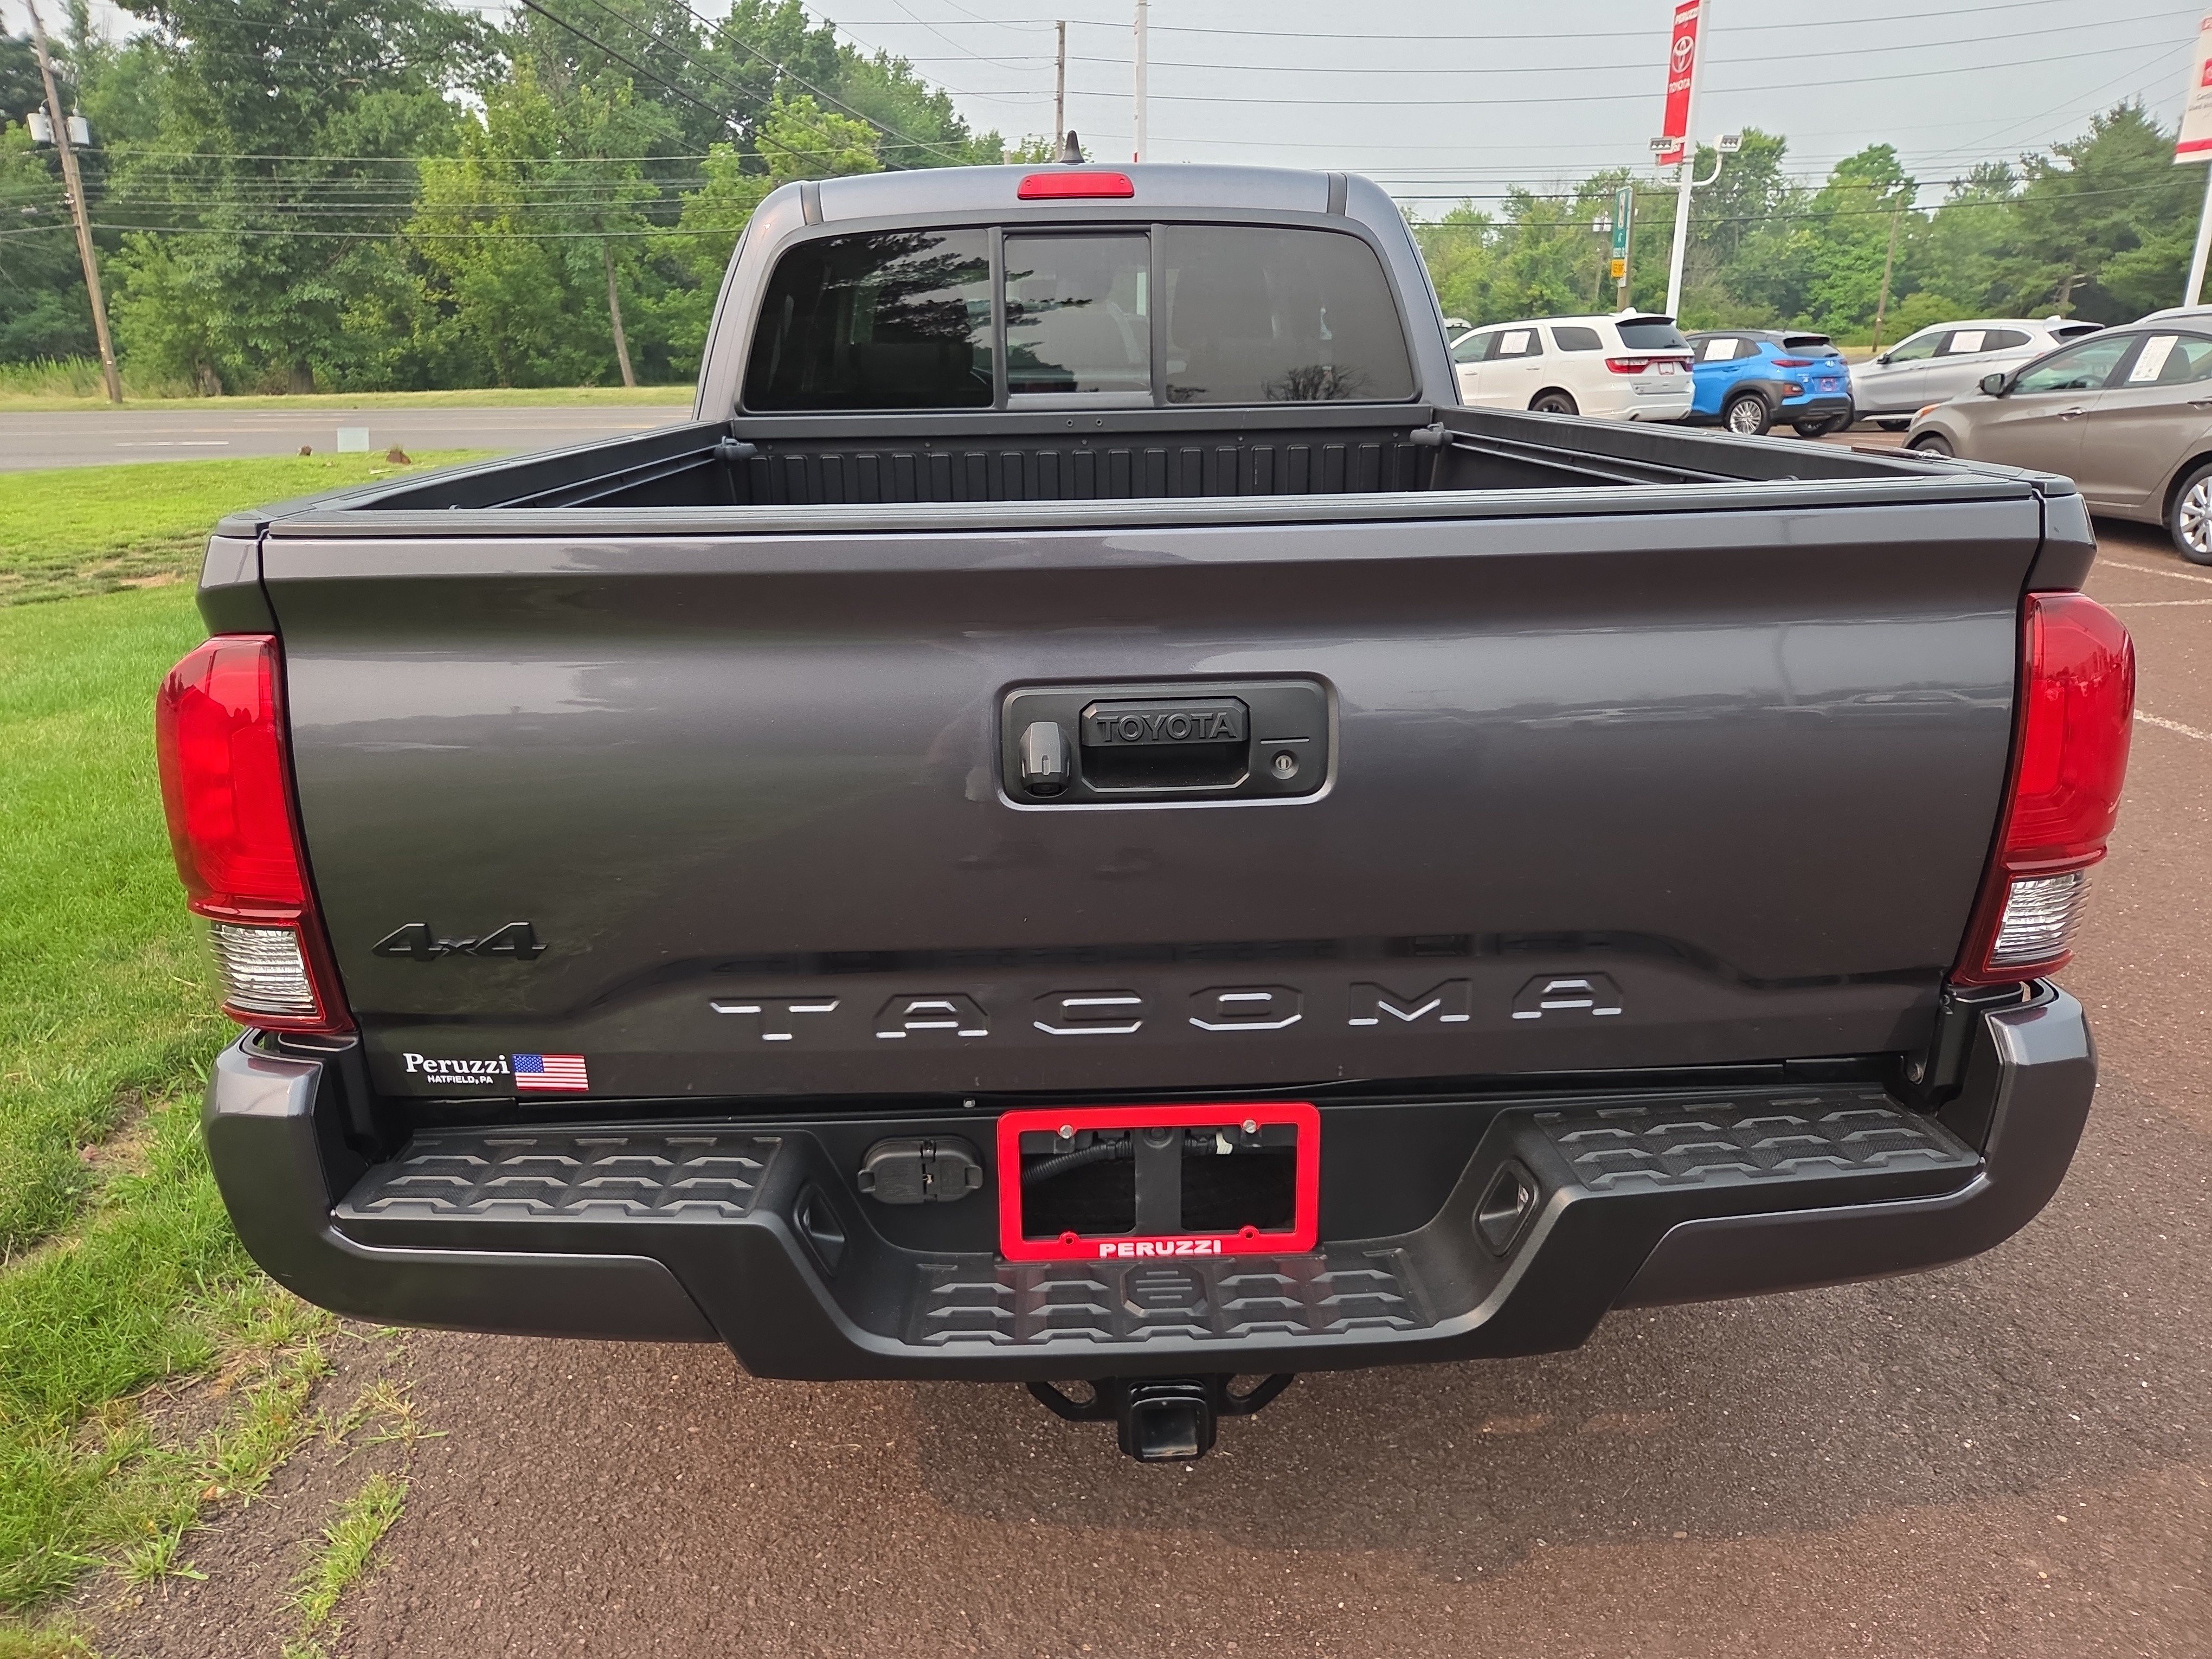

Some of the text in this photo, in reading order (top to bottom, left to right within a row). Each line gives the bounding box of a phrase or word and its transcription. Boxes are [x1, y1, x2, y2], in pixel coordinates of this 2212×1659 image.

[1669, 78, 1690, 93] TOYOTA
[1096, 712, 1237, 742] TOYOTA
[372, 921, 549, 961] 4x4
[710, 972, 1623, 1041] TACOMA
[402, 1052, 510, 1075] Peruzzi
[1099, 1239, 1222, 1258] PERUZZI
